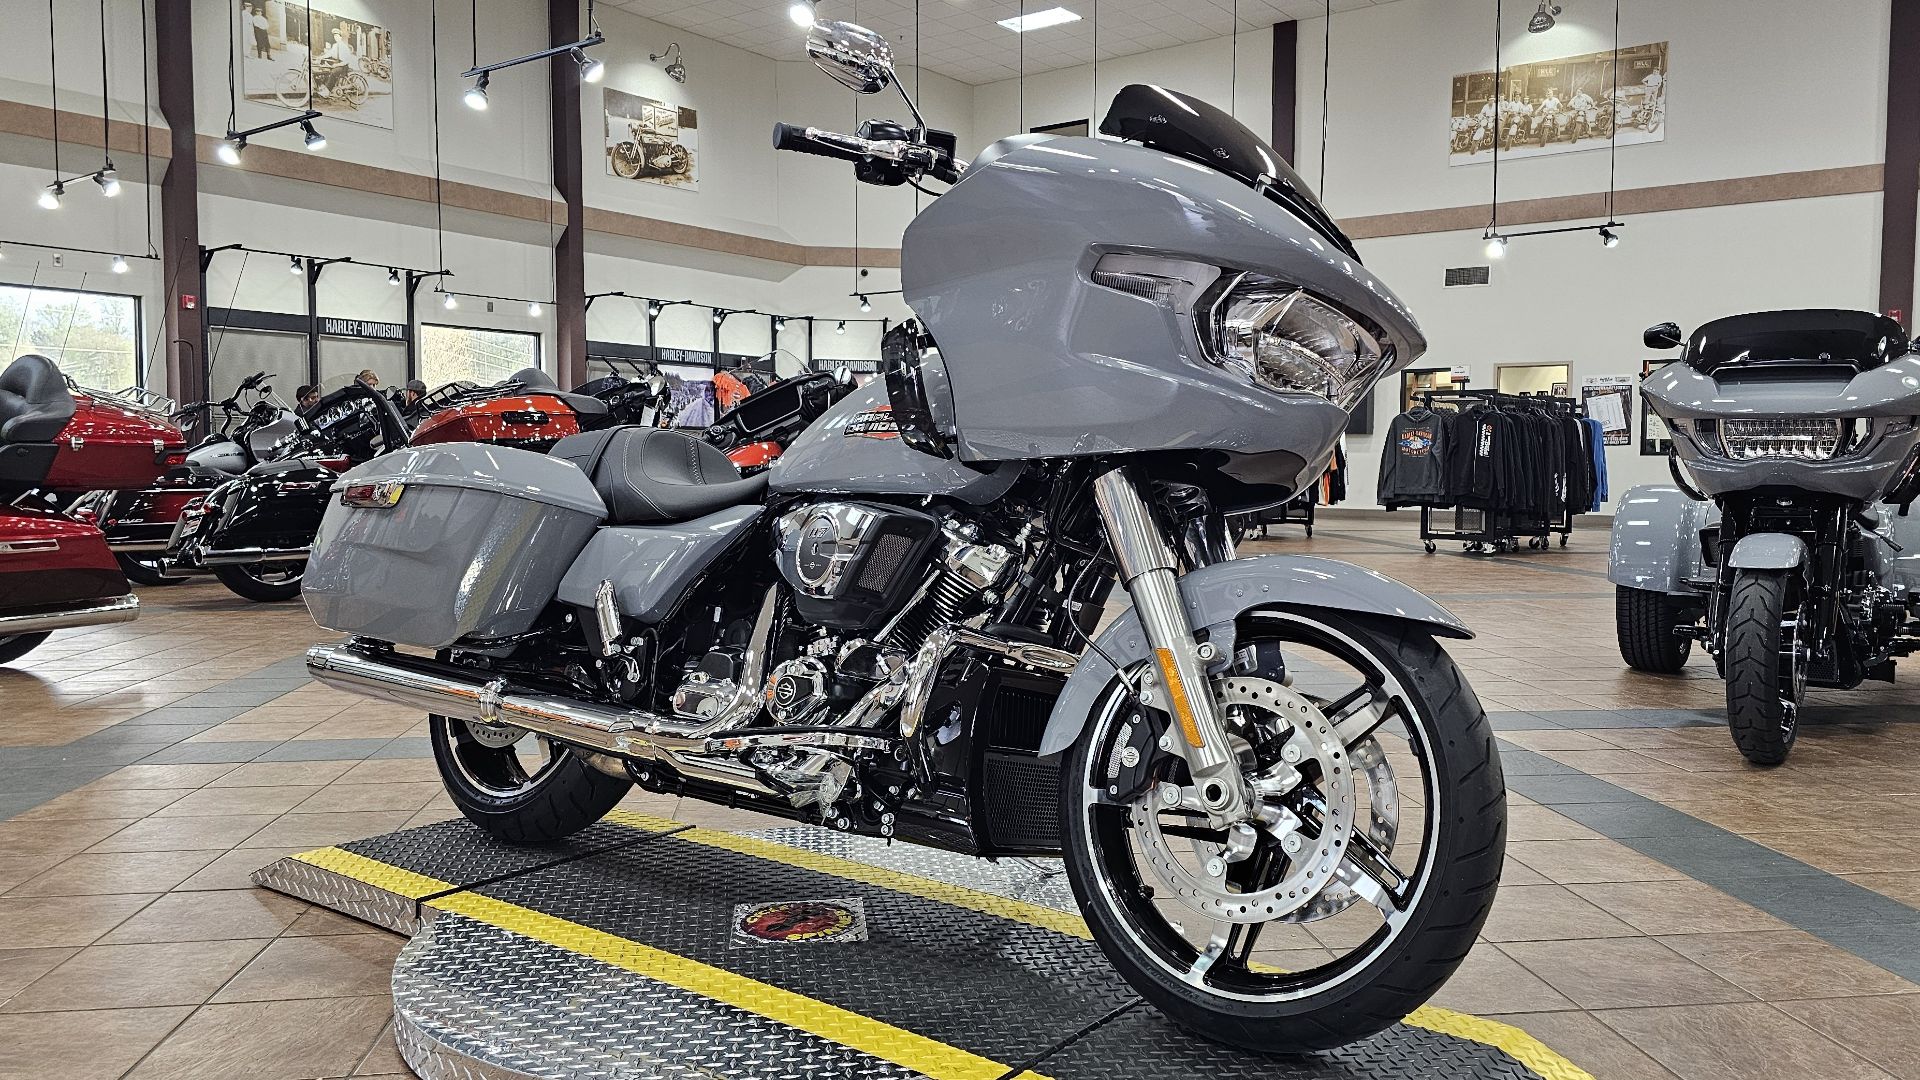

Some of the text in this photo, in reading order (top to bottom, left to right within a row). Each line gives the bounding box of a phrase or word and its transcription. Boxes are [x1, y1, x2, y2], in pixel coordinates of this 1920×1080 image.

[325, 318, 403, 339] HARLEY-DAVIDSON
[661, 348, 712, 364] HARLEY-DAVIDSON
[818, 359, 877, 371] HARLEYDAVIDSON
